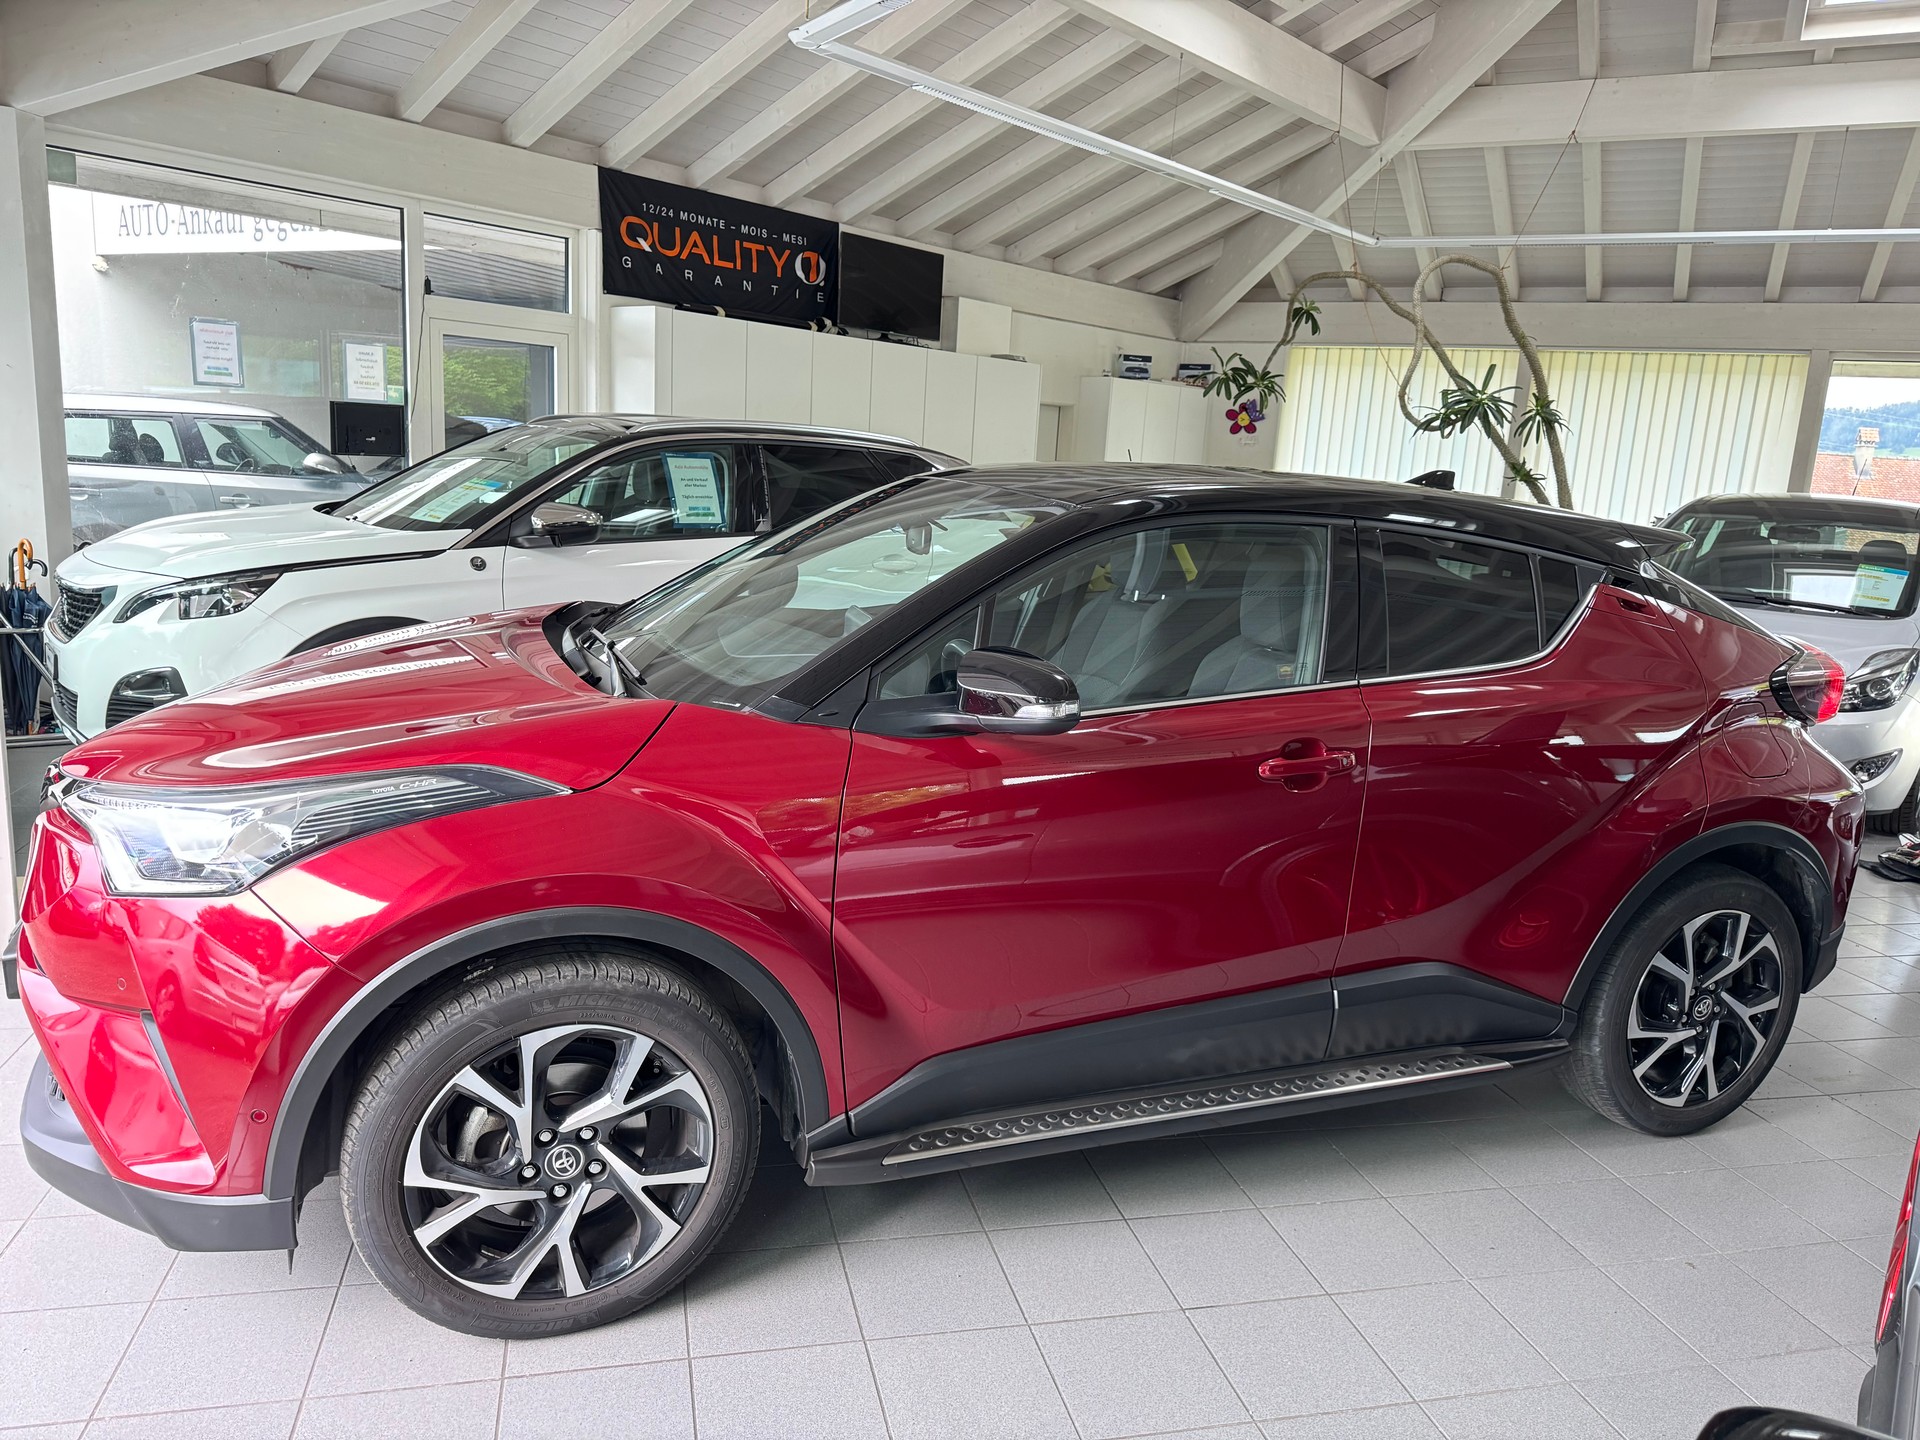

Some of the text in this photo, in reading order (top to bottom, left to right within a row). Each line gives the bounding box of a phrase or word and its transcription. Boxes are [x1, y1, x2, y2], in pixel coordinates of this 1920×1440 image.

[642, 202, 675, 218] 12/24
[679, 211, 727, 230] MONATE
[740, 224, 768, 239] MOIS
[782, 232, 808, 246] MESI
[619, 215, 791, 278] QUALITY
[621, 256, 826, 303] GARANTIE
[371, 778, 437, 794] TOYOTA C-HR
[557, 993, 660, 1021] MICHELIN
